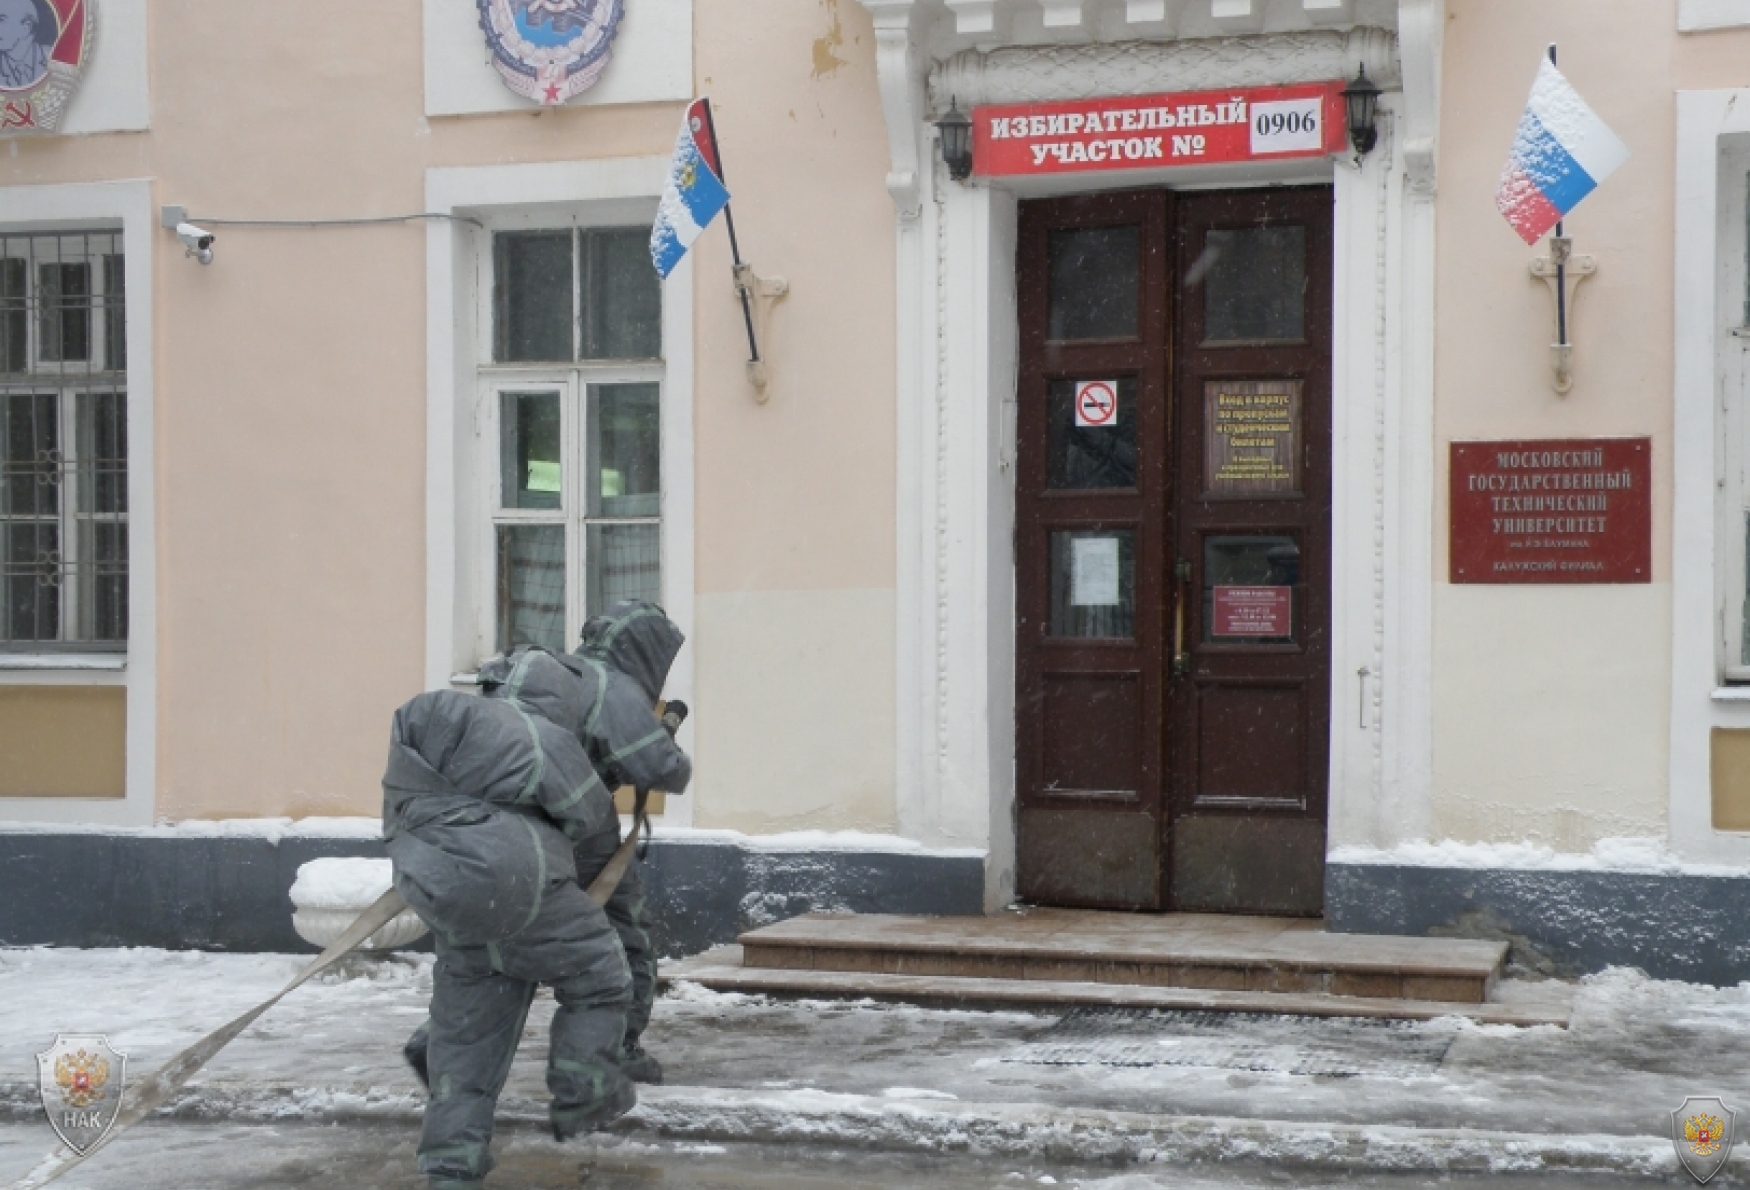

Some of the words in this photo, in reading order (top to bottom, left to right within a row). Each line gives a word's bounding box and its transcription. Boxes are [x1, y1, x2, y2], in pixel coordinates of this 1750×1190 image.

[990, 97, 1247, 139] ИЗБИРАТЕЛЬНЫЙ
[1256, 110, 1317, 136] 0906
[1030, 135, 1163, 166] УЧАСТОК
[1172, 134, 1206, 157] №
[1497, 447, 1602, 468] МОСКОВСКИЙ
[1468, 468, 1632, 491] ГОСУДАРСТВЕННЫЙ
[1492, 491, 1607, 512] ТЕХНИЧЕСКИЙ
[1492, 516, 1607, 534] УНИВЕРСИТЕТ
